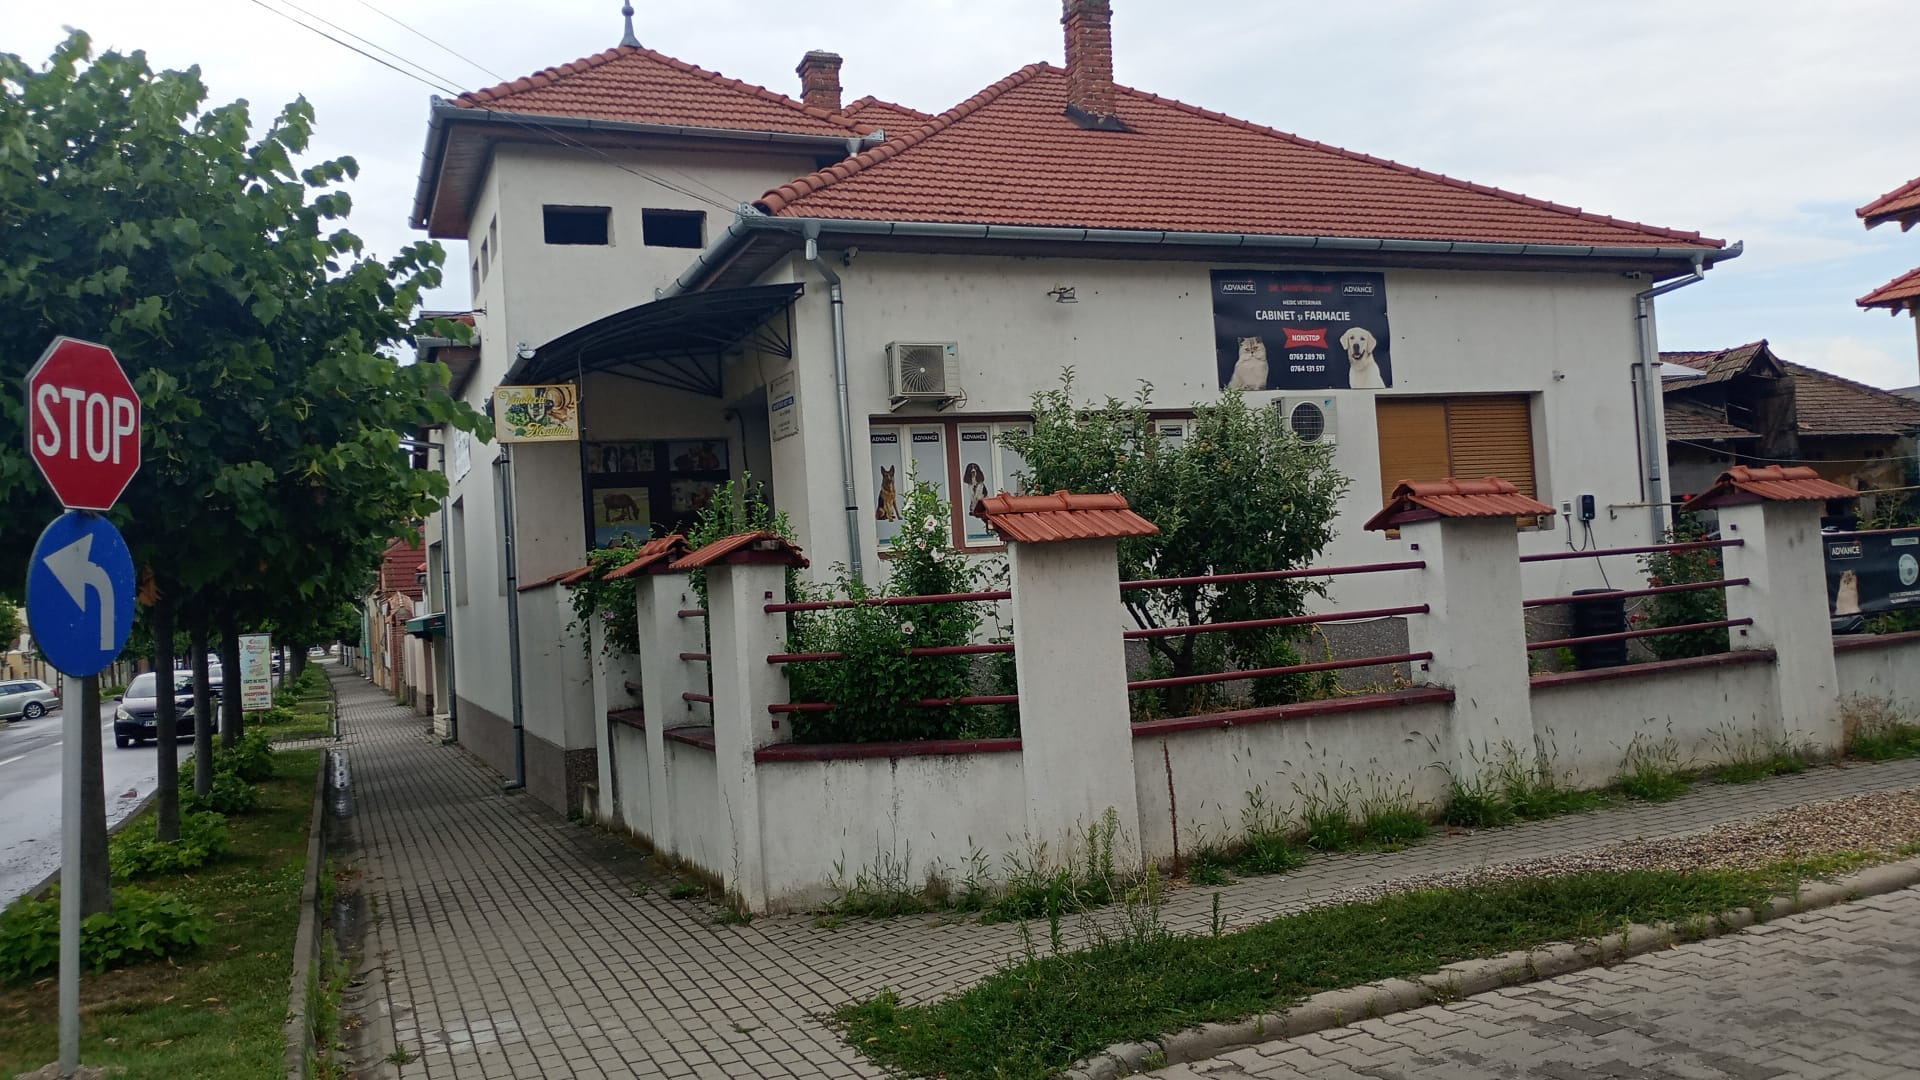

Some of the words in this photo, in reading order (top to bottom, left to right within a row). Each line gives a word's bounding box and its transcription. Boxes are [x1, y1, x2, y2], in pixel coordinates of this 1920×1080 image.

[1222, 283, 1255, 292] ADVANCE
[1343, 285, 1373, 294] ADVANCE
[1255, 310, 1295, 321] CABINET
[1304, 310, 1351, 321] FARMACIE
[1291, 334, 1321, 342] NONSTOP
[36, 383, 136, 465] STOP
[871, 434, 897, 443] ADVANCE
[913, 433, 939, 442] ADVANCE
[962, 433, 987, 441] ADVANCE
[1831, 545, 1861, 556] ADVANCE
